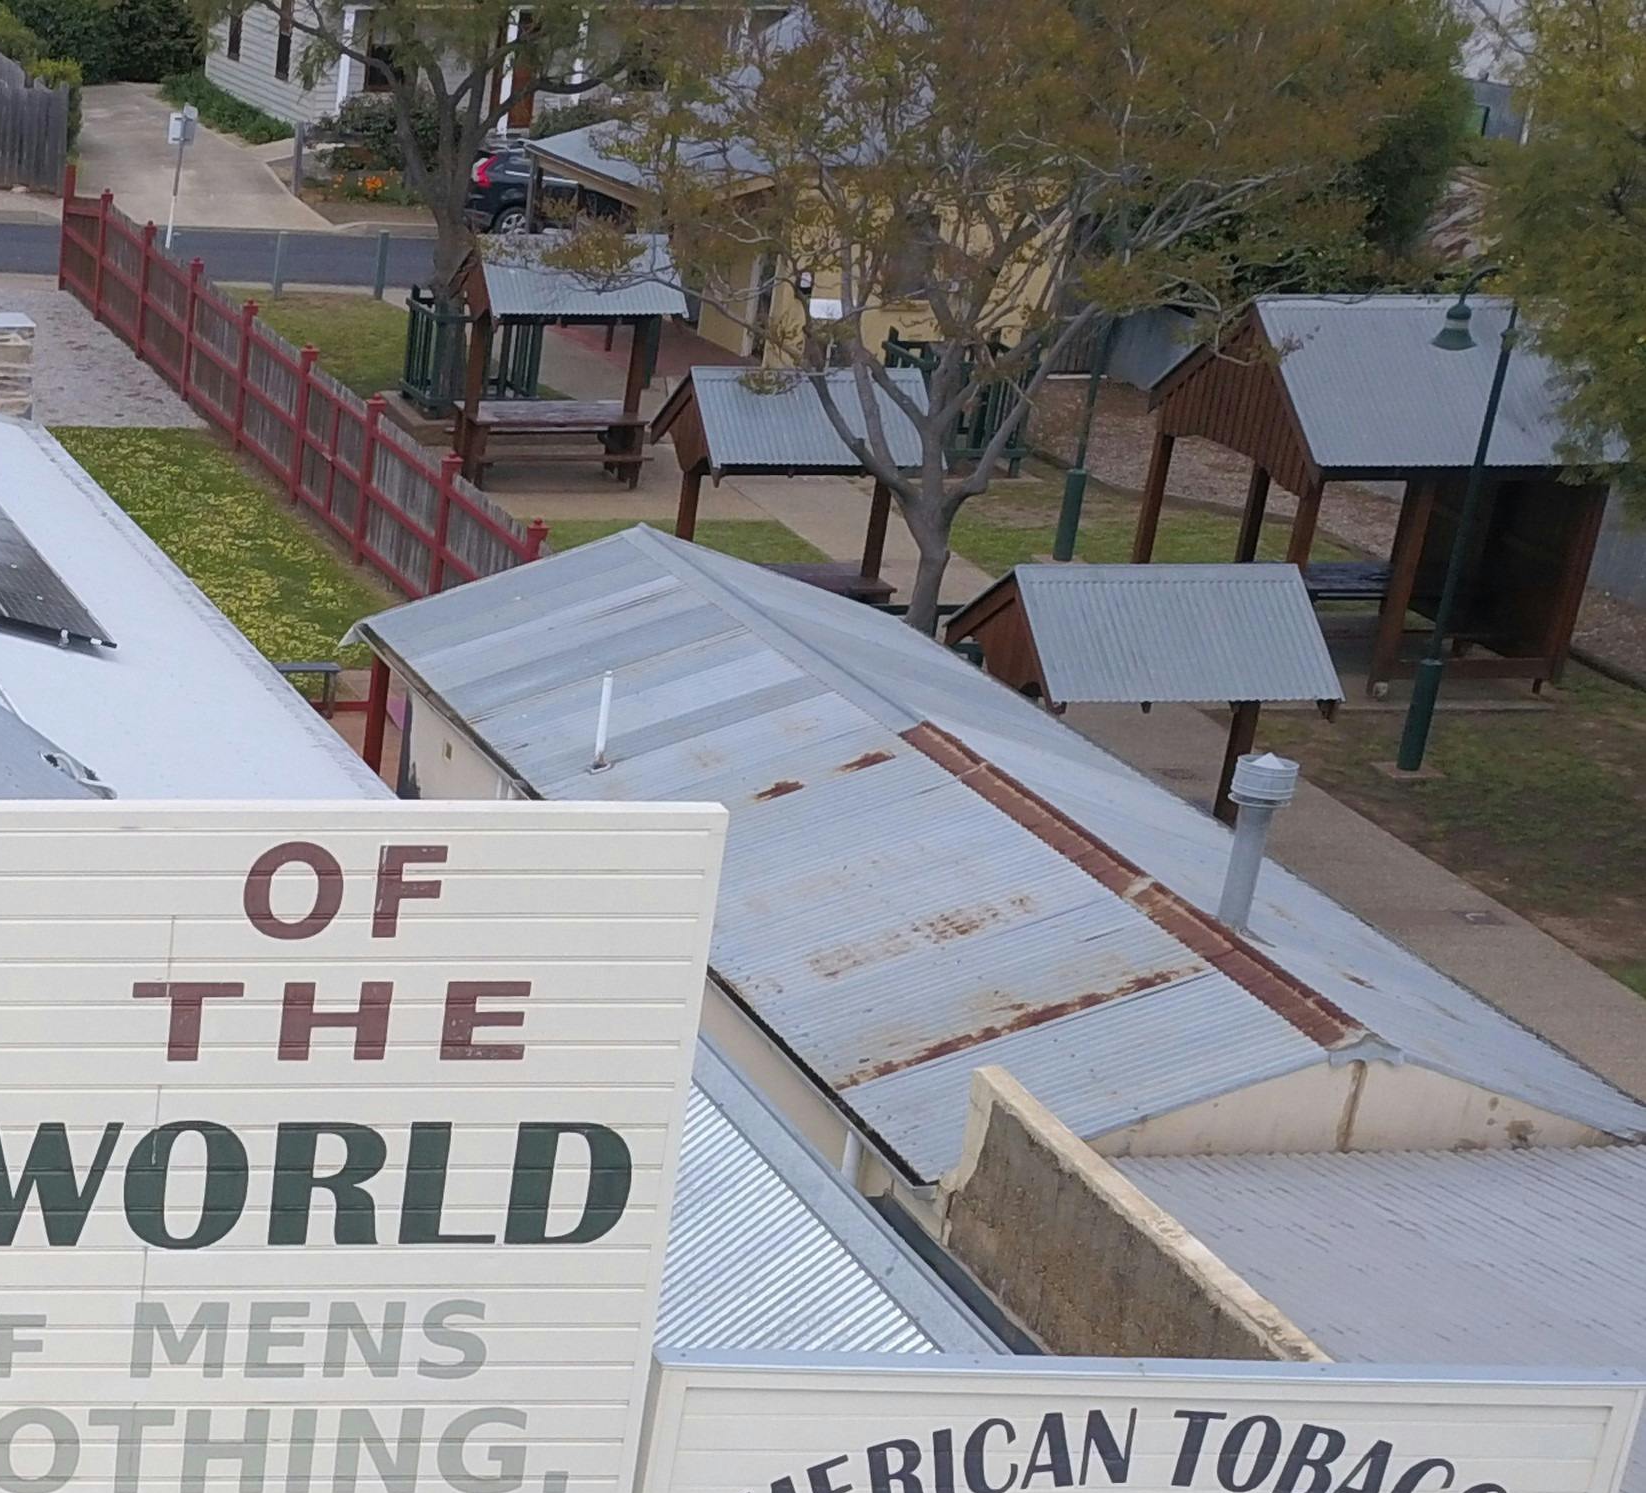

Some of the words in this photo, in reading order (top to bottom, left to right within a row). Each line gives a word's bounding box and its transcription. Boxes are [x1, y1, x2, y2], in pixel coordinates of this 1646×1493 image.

[244, 842, 448, 939] OF
[133, 981, 531, 1061] THE
[130, 1300, 486, 1379] MENS
